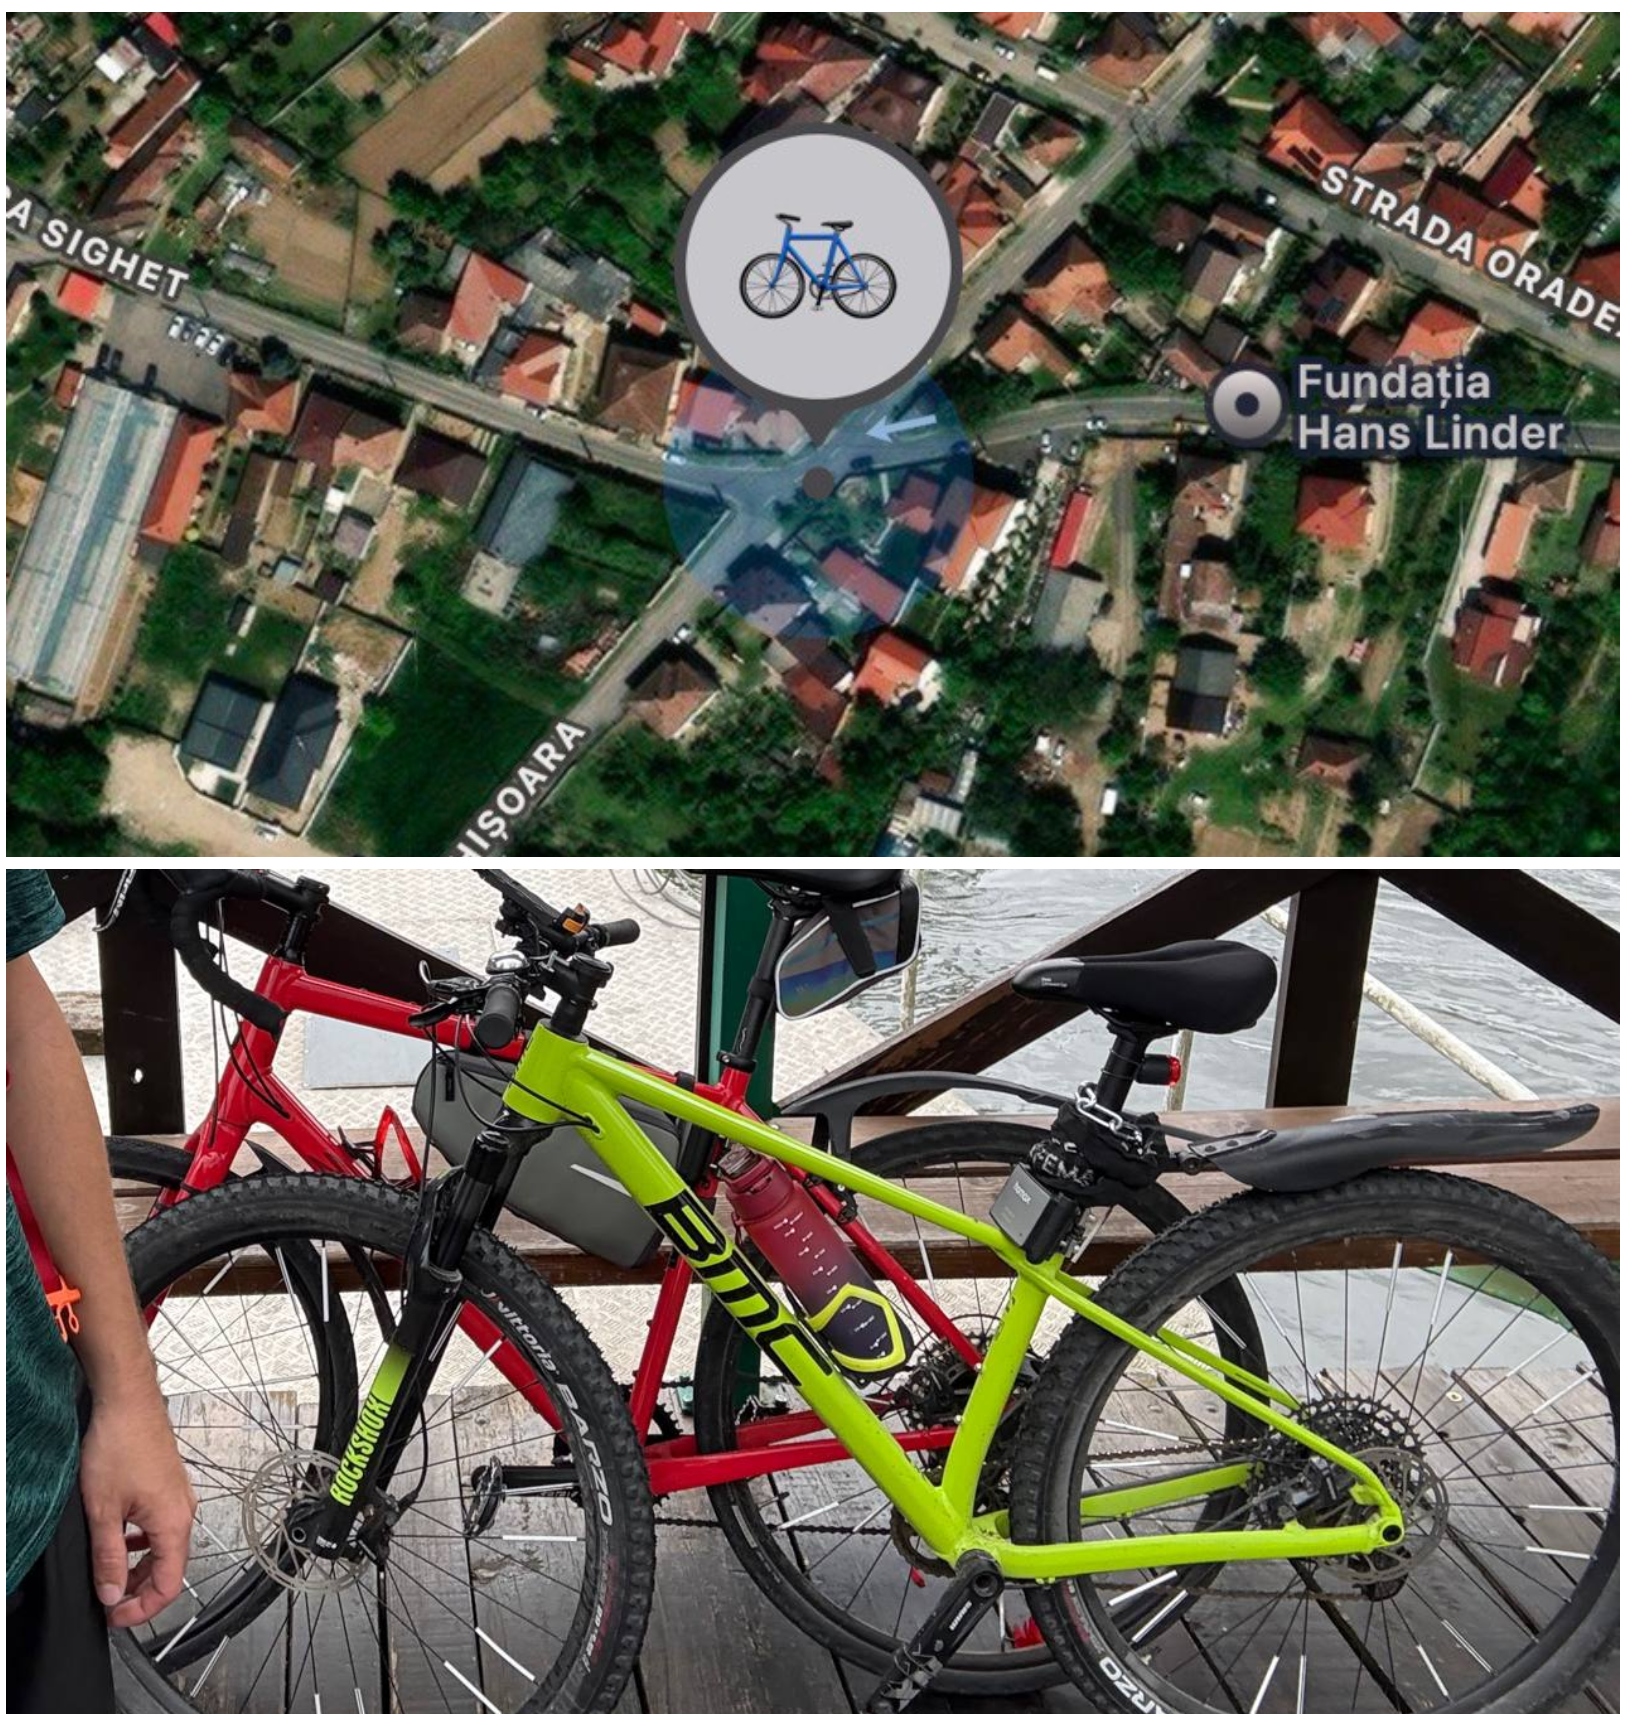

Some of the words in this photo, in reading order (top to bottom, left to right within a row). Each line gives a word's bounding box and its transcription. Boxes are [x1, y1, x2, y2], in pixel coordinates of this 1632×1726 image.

[645, 1190, 834, 1386] BMC
[330, 1394, 392, 1507] ROCKSHOX
[497, 1302, 558, 1374] vittoria
[555, 1383, 614, 1527] BARZO
